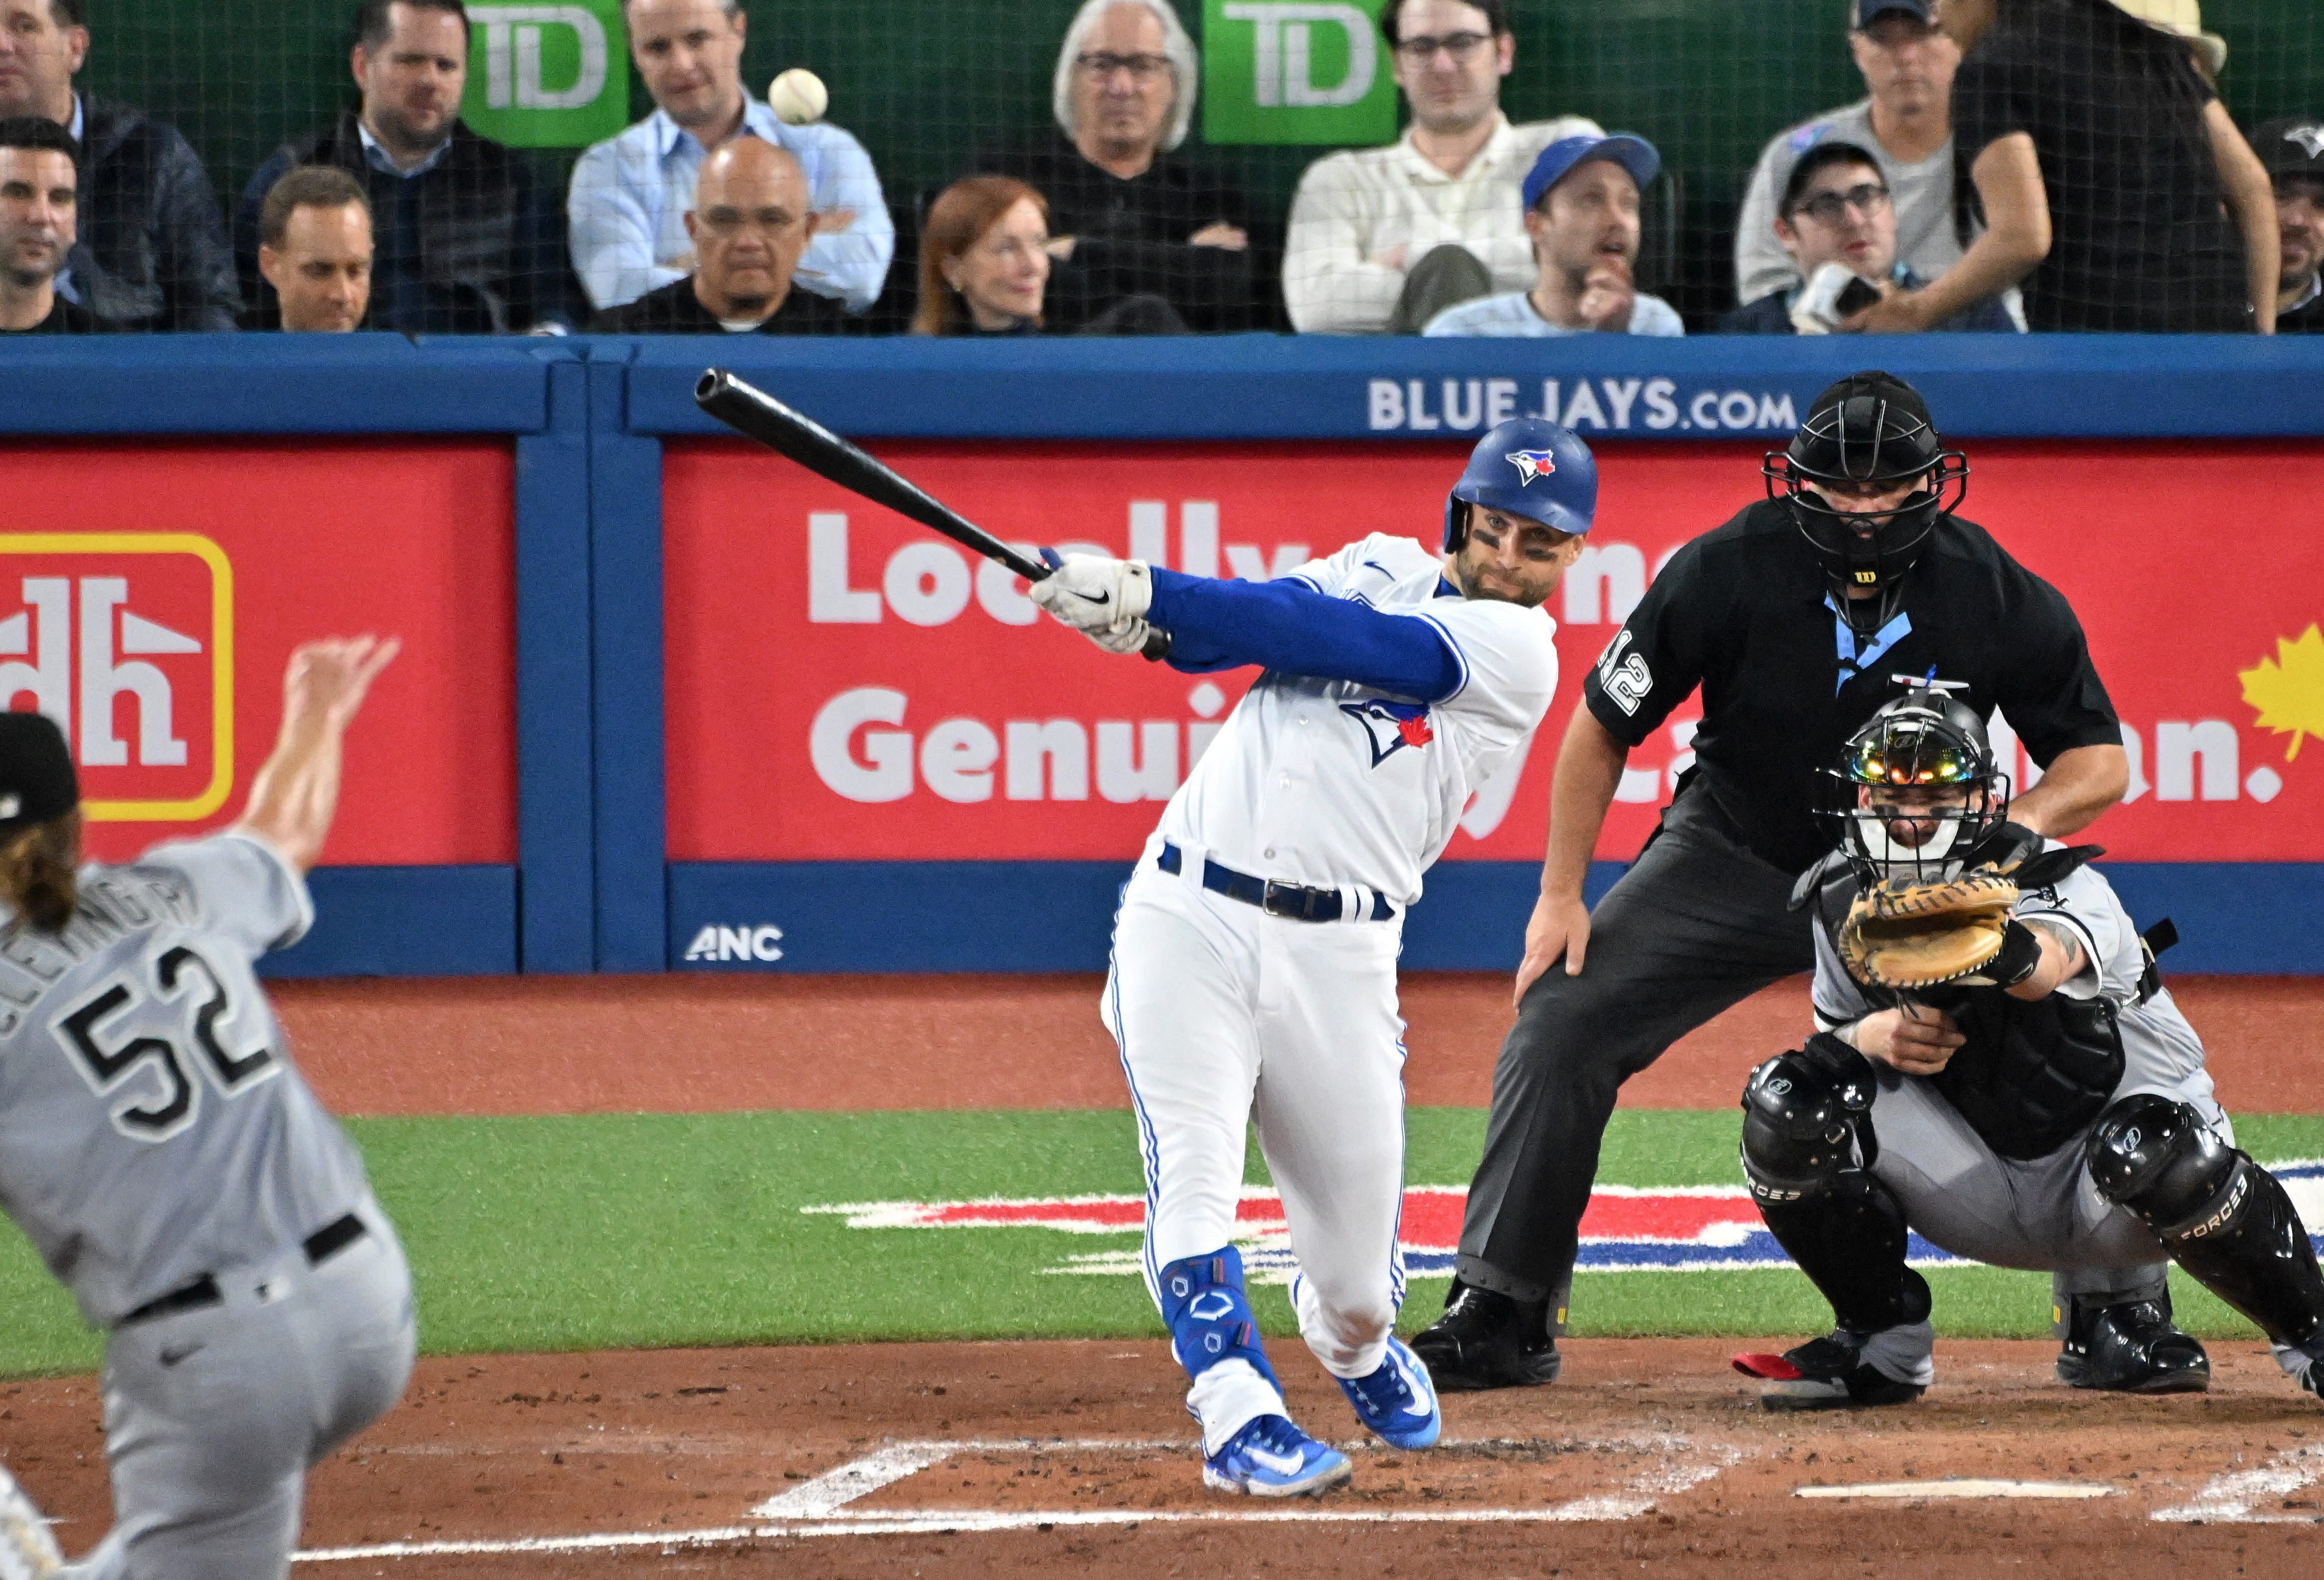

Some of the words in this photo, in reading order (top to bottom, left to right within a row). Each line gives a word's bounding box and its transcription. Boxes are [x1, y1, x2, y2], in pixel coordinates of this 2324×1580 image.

[463, 6, 607, 110] TD
[1222, 4, 1376, 108] TD
[808, 502, 1308, 627] Locll
[684, 924, 785, 961] ANC
[48, 939, 282, 1143] 52
